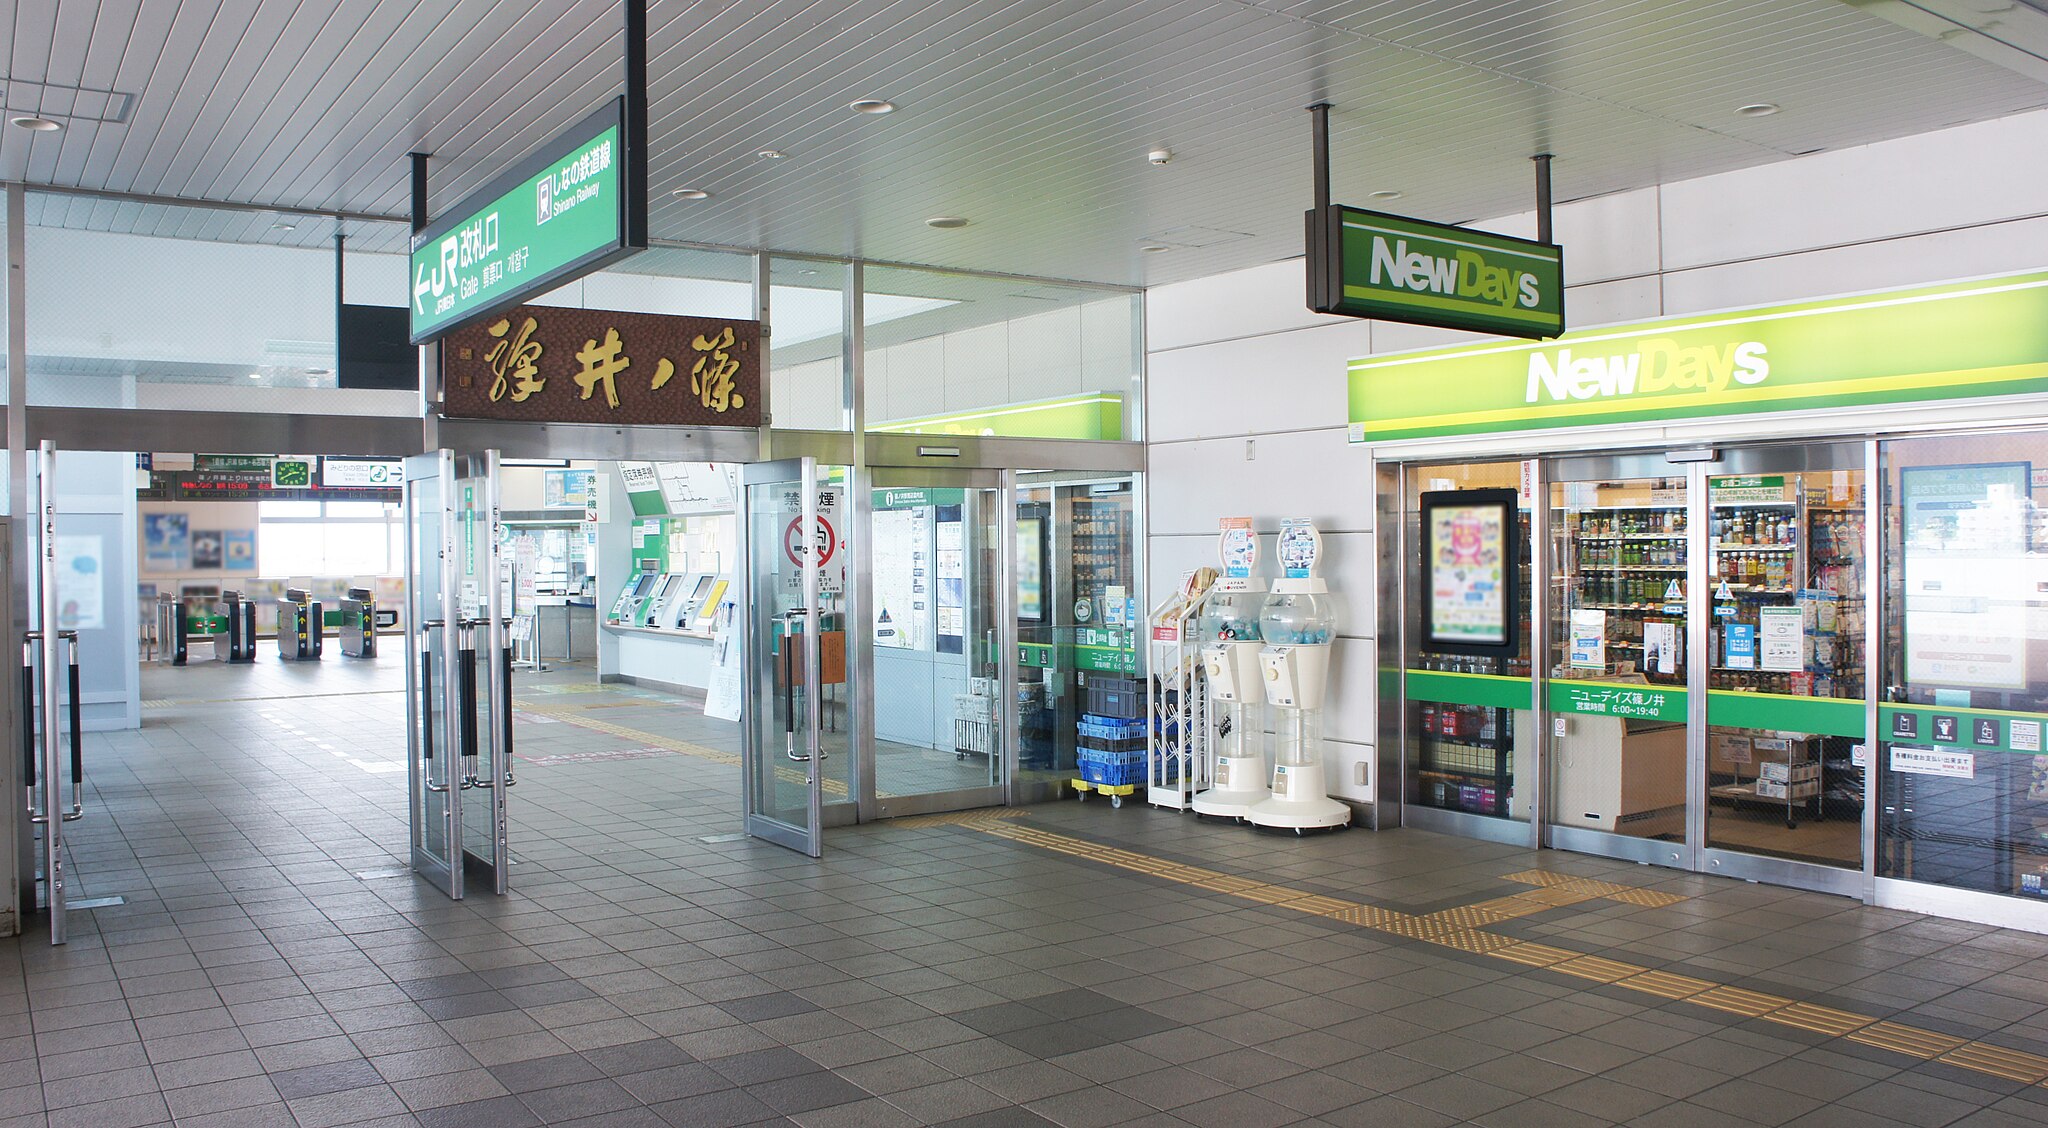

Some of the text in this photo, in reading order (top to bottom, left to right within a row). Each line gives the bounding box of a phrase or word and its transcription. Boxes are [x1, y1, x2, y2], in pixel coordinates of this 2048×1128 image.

[553, 140, 611, 196] しなの鉄道線
[553, 182, 600, 216] Shinano Railway
[461, 212, 498, 268] 改札口
[432, 235, 459, 297] JR
[1370, 236, 1540, 308] NewDays
[461, 275, 479, 300] Gate
[1525, 338, 1769, 403] NewDays
[587, 474, 597, 510] 券売機
[1570, 689, 1665, 706] ニューデイズ篠ノ井
[1576, 701, 1606, 712] 営業時間
[1895, 752, 1969, 765] 各種料金お支払い出来ます
